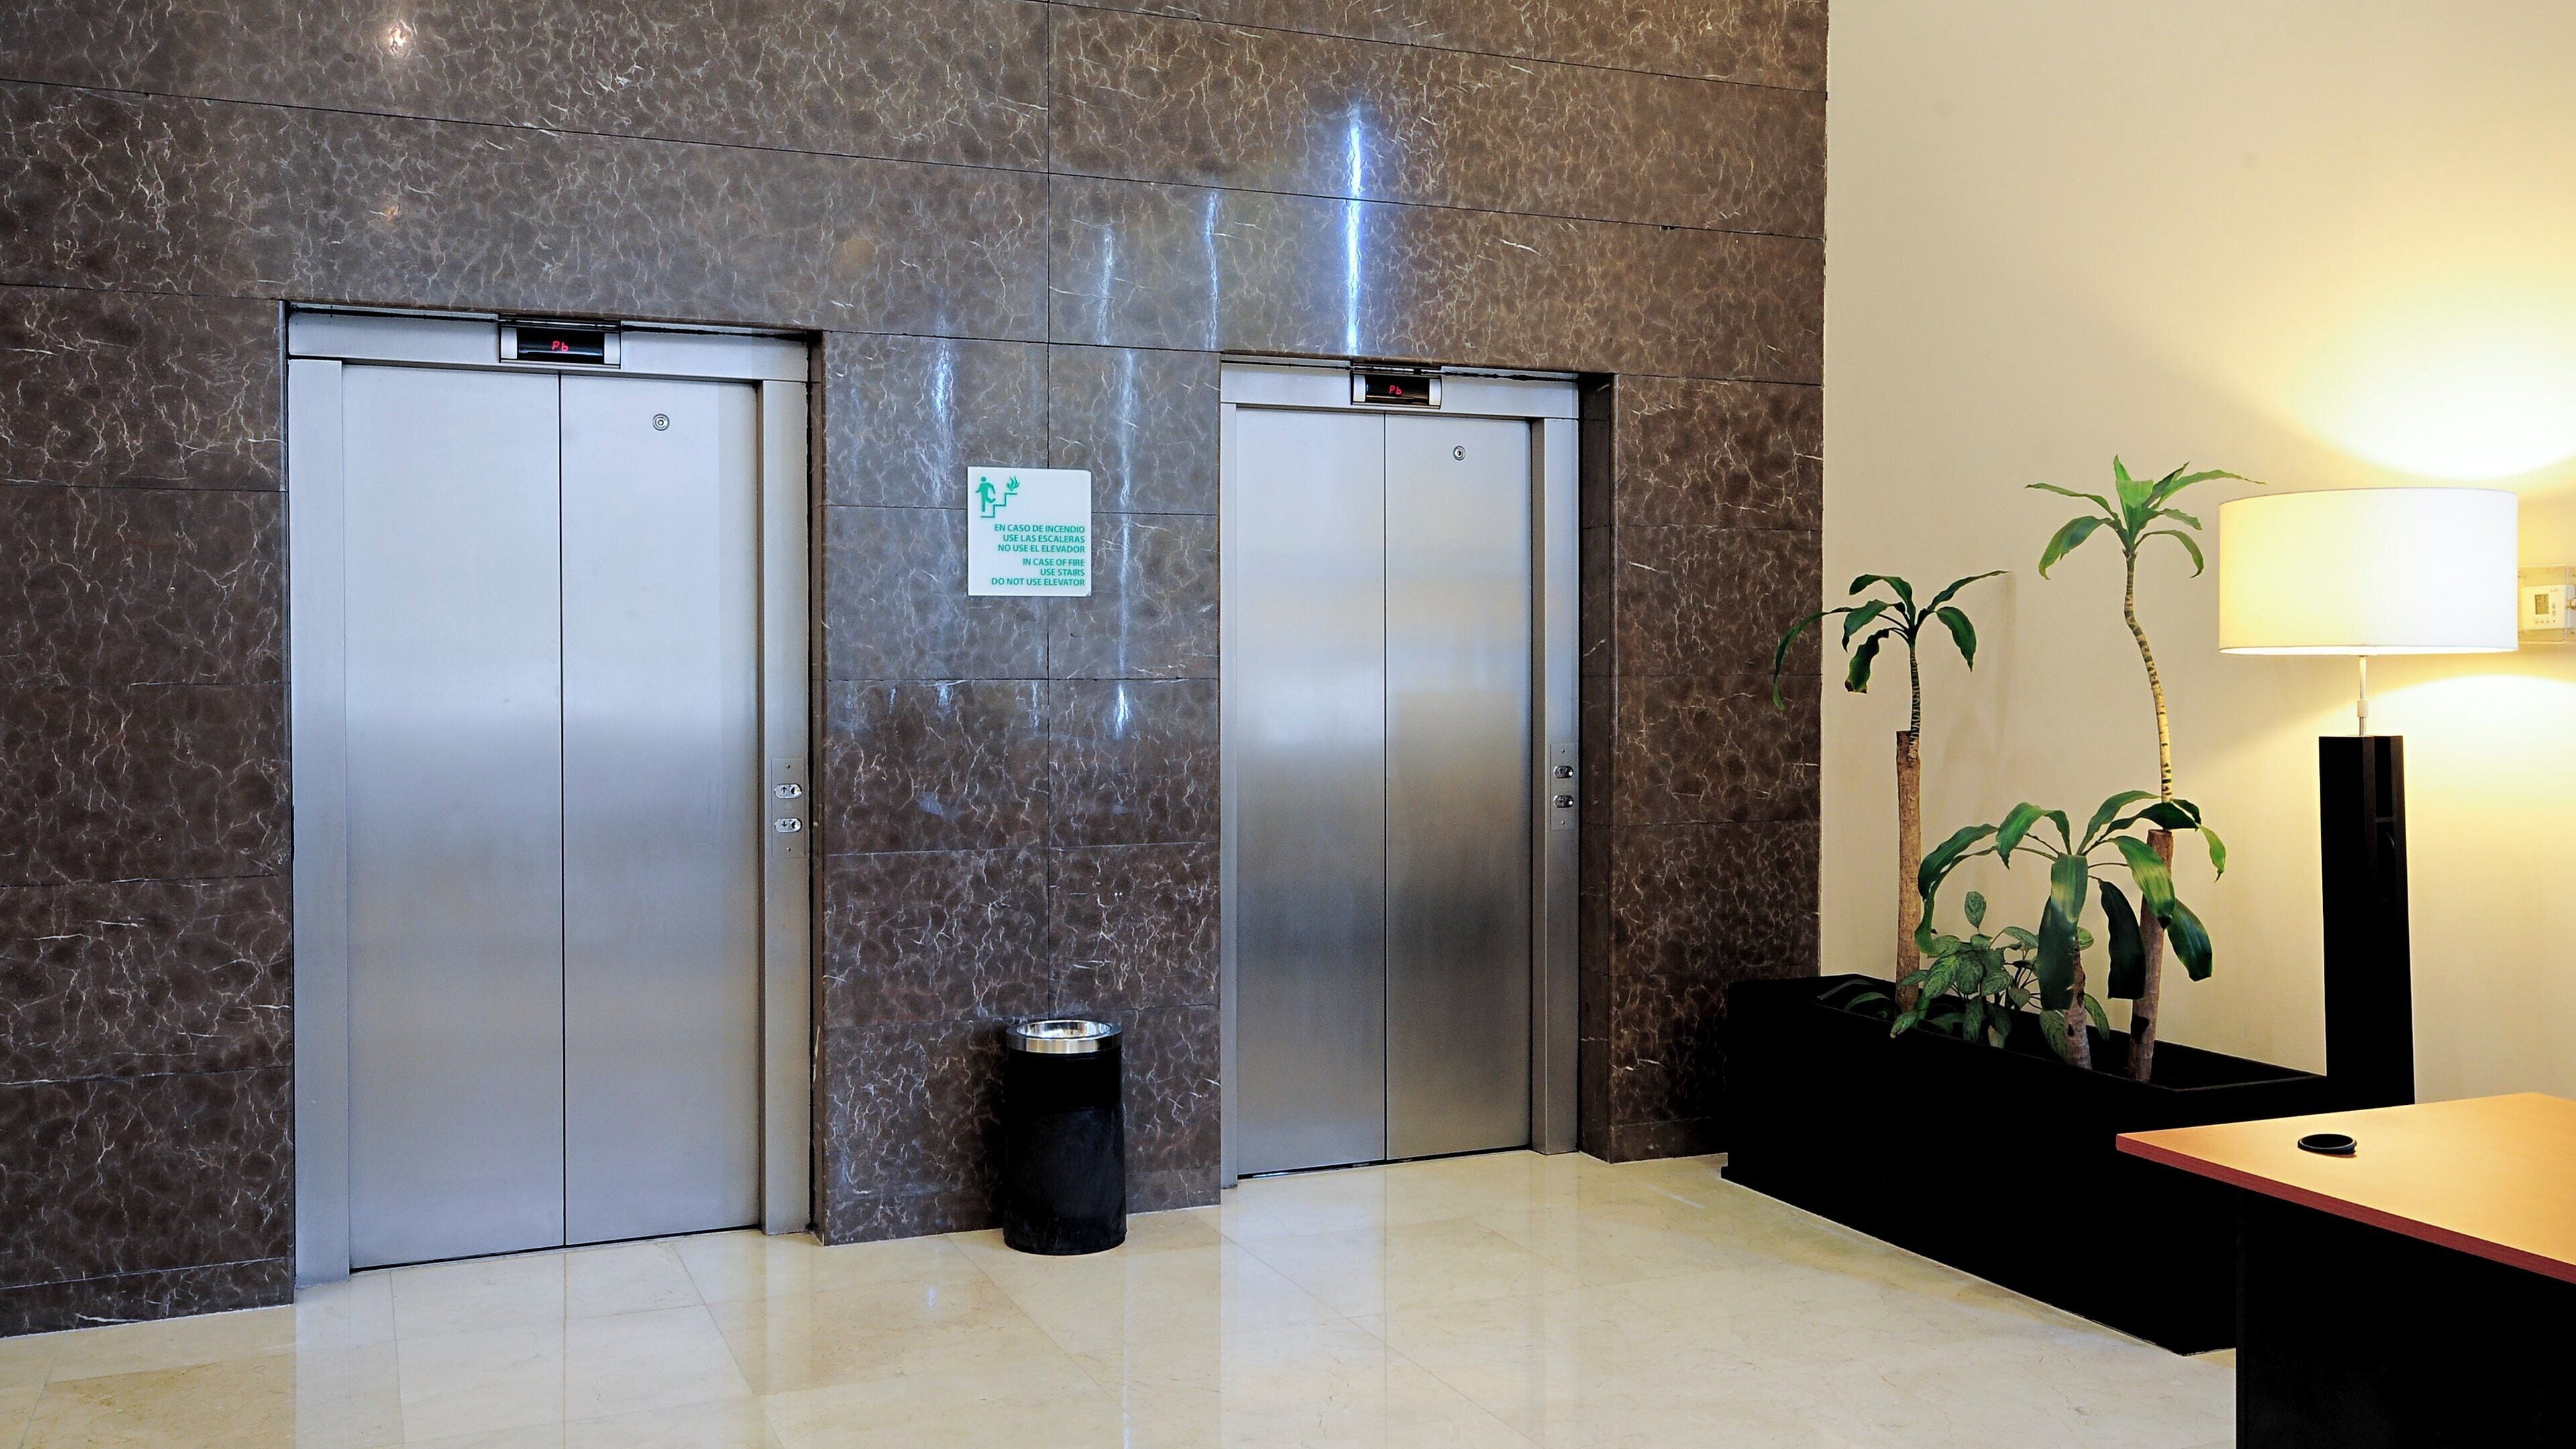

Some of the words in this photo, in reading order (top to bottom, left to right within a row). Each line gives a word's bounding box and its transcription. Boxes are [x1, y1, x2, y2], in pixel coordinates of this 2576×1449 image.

[994, 523, 1006, 531] EN
[1008, 524, 1031, 532] CASO
[1045, 525, 1085, 533] INCENDIO
[1003, 534, 1019, 542] USE
[1038, 535, 1085, 543] ESCALERAS
[1013, 544, 1028, 552] USE
[1041, 545, 1085, 553] ELEVADOR
[1056, 558, 1067, 566] OF
[1058, 568, 1085, 576] STAIRS
[1006, 578, 1024, 586] NOT
[1026, 578, 1042, 586] USE
[1044, 578, 1085, 586] ELEVATOR
